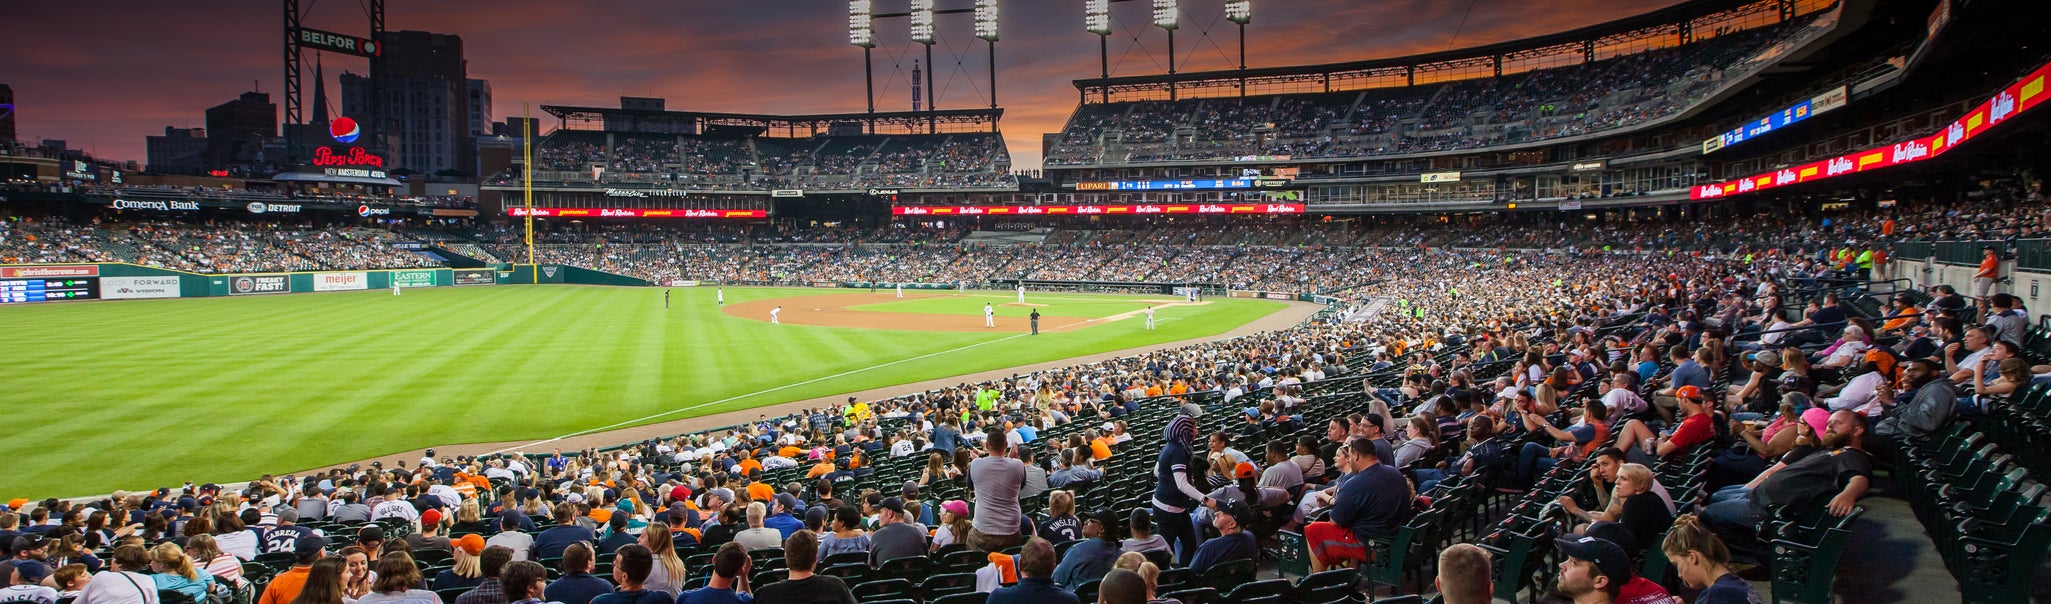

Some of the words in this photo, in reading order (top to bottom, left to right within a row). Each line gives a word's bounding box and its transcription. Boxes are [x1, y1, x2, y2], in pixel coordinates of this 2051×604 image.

[302, 30, 355, 50] BELFOR
[313, 146, 346, 166] PEPSI
[347, 146, 382, 167] PORCH
[325, 168, 337, 176] NEW
[338, 169, 370, 177] AMSTERDAM
[170, 201, 199, 210] Bank
[268, 204, 301, 212] DETROIT
[370, 208, 389, 216] pepsi
[685, 209, 699, 217] Red
[699, 209, 717, 217] Robin
[326, 273, 357, 285] meijer
[394, 272, 431, 280] EASTERN
[255, 282, 284, 291] FAST!
[381, 502, 403, 515] IGLESIAS
[1049, 518, 1077, 532] KINSLER
[266, 529, 300, 542] CABRERA
[267, 538, 296, 552] 24
